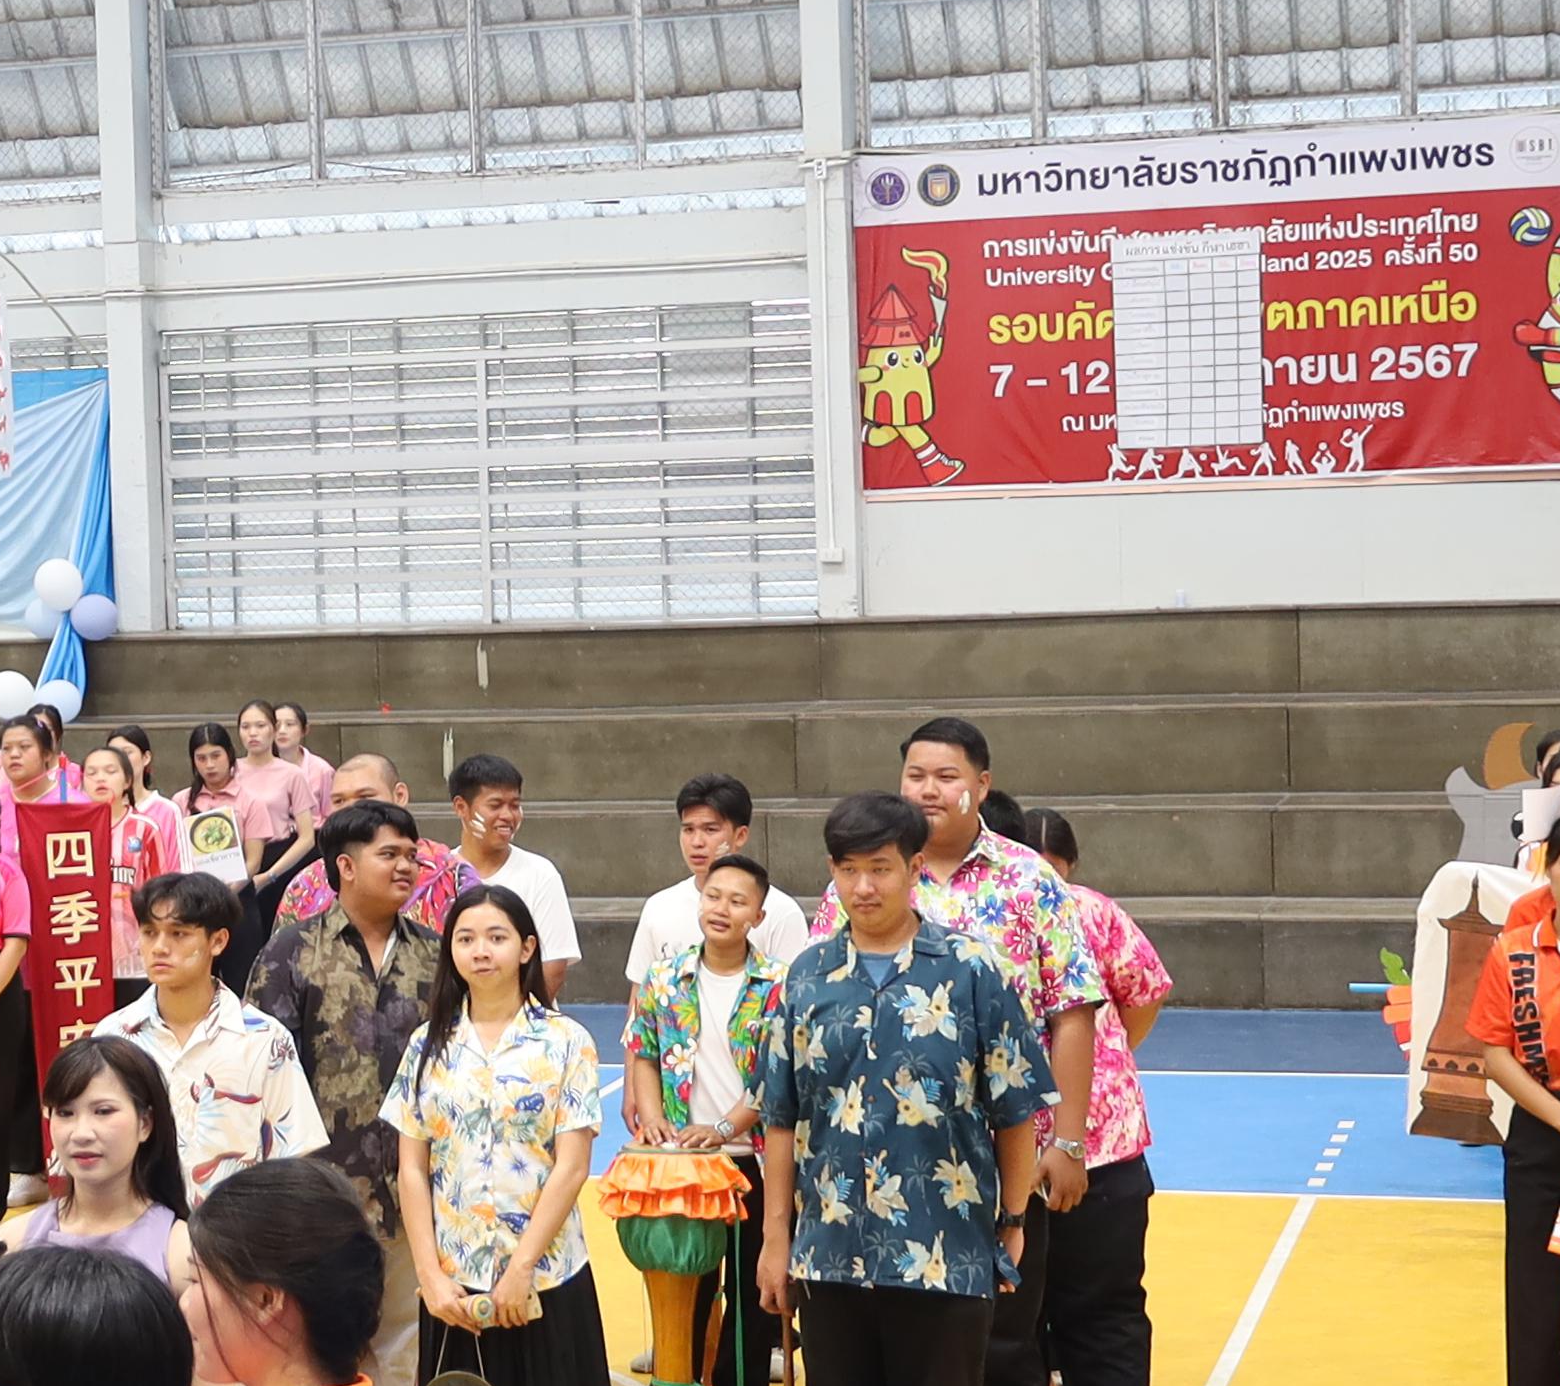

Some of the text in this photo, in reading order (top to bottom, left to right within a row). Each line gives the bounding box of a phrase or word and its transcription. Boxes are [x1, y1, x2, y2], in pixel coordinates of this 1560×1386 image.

[977, 142, 1495, 198] มหาวิทยาลัยราชภัฏกำแพงเพชร
[985, 261, 1096, 288] University
[1260, 250, 1310, 274] land
[1314, 247, 1373, 270] 2025
[1383, 235, 1444, 268] ครั้งที่
[1447, 241, 1478, 264] 50
[988, 279, 1478, 344] รอบคัด ตภาคเหนือ
[989, 364, 1014, 398] 7
[1060, 360, 1110, 396] 12
[1370, 342, 1478, 382] 2567
[1061, 414, 1084, 432] ณ
